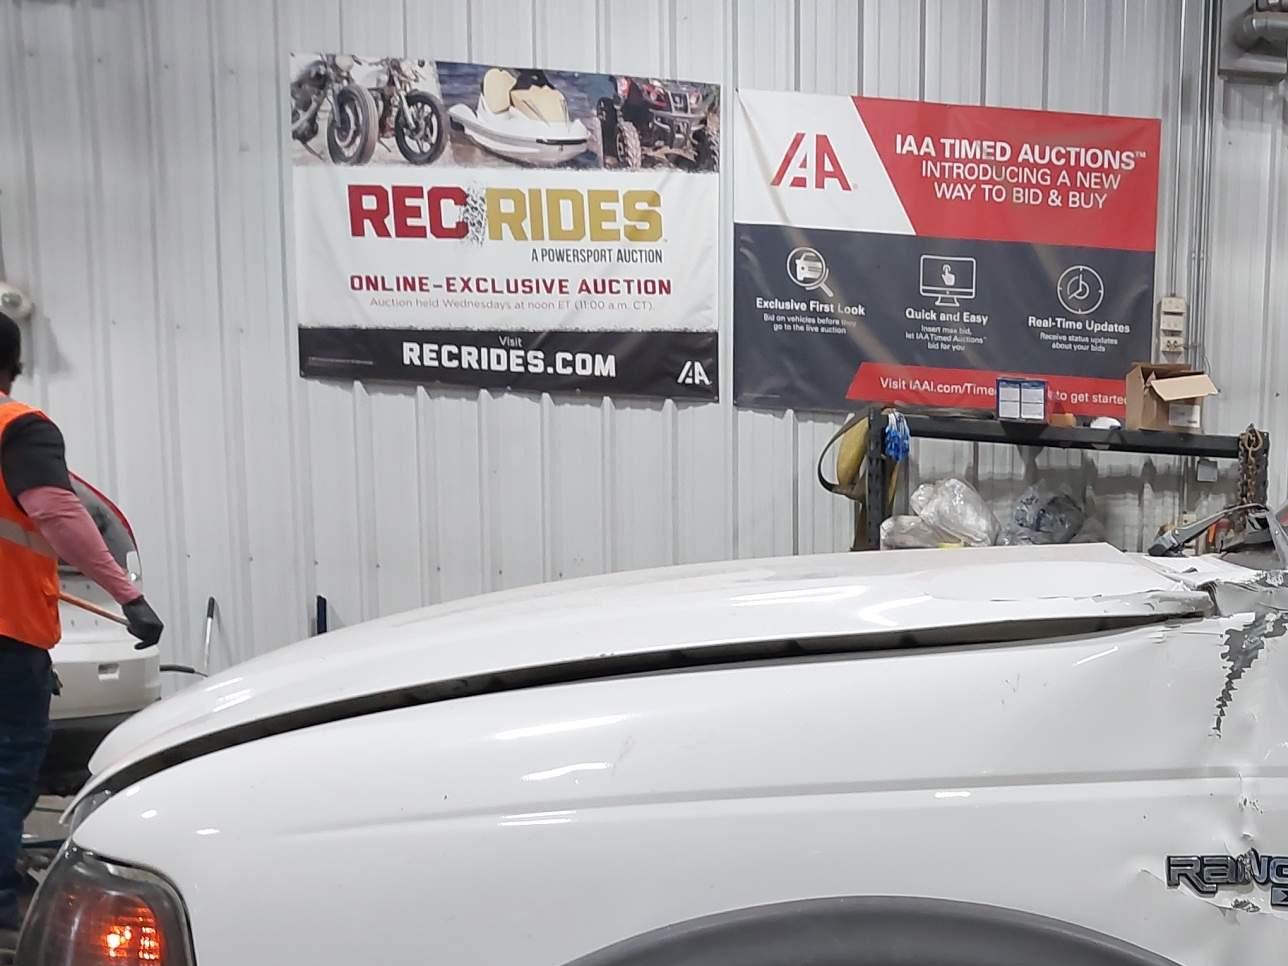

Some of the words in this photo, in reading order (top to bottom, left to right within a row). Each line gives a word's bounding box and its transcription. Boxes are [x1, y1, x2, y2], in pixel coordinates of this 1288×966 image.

[896, 134, 935, 157] IAA
[940, 139, 1011, 162] TIMED
[922, 161, 1051, 186] INTRODUCING
[1057, 171, 1071, 187] A
[1077, 173, 1121, 190] NEW
[934, 182, 976, 201] WAY
[981, 185, 1006, 203] TO
[1012, 187, 1042, 206] BID
[1048, 190, 1062, 207] &
[1069, 192, 1107, 210] BUY
[347, 184, 470, 240] REC
[486, 187, 664, 242] RIDES
[531, 248, 539, 262] A
[541, 248, 613, 263] POWERSPORT
[616, 249, 663, 263] AUCTION
[350, 275, 570, 295] ONLINE-EXCLUSIVE
[578, 278, 672, 295] AUCTION
[370, 297, 412, 307] Auction
[415, 298, 440, 308] held
[442, 299, 511, 311] Wednesdays
[514, 301, 525, 309] at
[527, 301, 554, 310] noon
[558, 301, 570, 310] ET
[756, 297, 807, 311] Exclusive
[809, 300, 834, 313] First
[837, 303, 865, 316] Look
[763, 313, 776, 322] Bid
[905, 307, 937, 321] Quick
[939, 310, 960, 323] and
[963, 312, 989, 326] Easy
[1029, 316, 1083, 330] Real-Time
[1086, 320, 1131, 333] Updates
[499, 336, 522, 348] Visit
[402, 342, 616, 377] RECRIDES.COM
[880, 377, 906, 390] Visit
[1070, 393, 1089, 404] get
